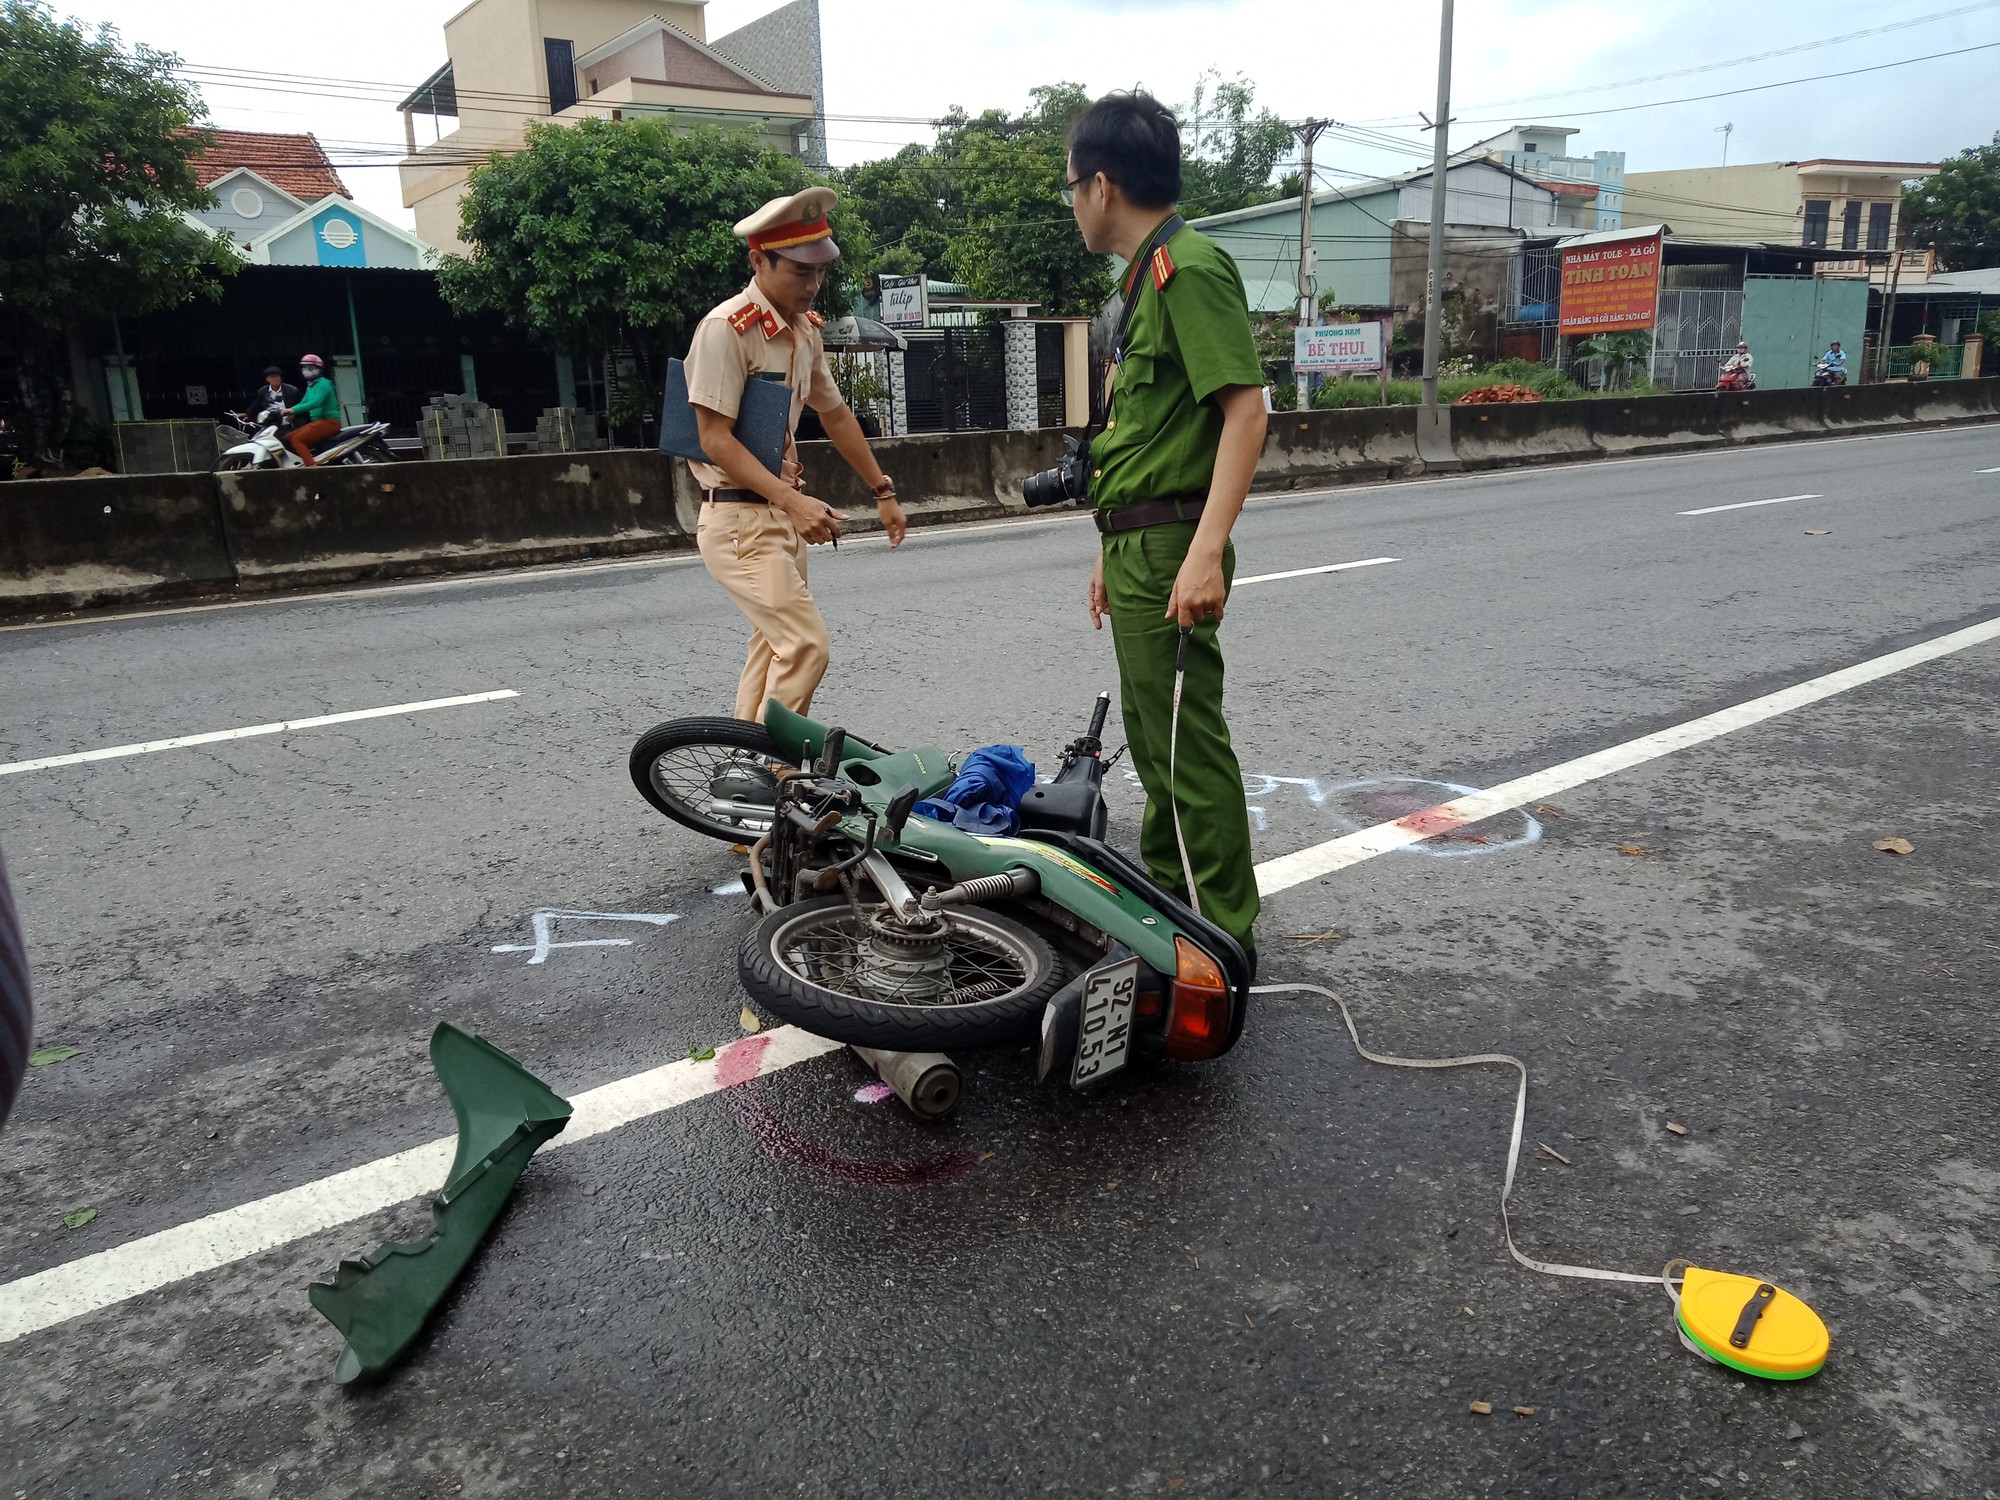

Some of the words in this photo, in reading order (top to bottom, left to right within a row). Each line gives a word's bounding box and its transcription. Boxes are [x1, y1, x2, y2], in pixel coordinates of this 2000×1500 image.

[1602, 250, 1622, 260] TOLE
[890, 290, 913, 310] tulip
[1330, 341, 1365, 355] THUI
[1104, 976, 1134, 1057] 92-N1
[1077, 977, 1111, 1080] 410.53
